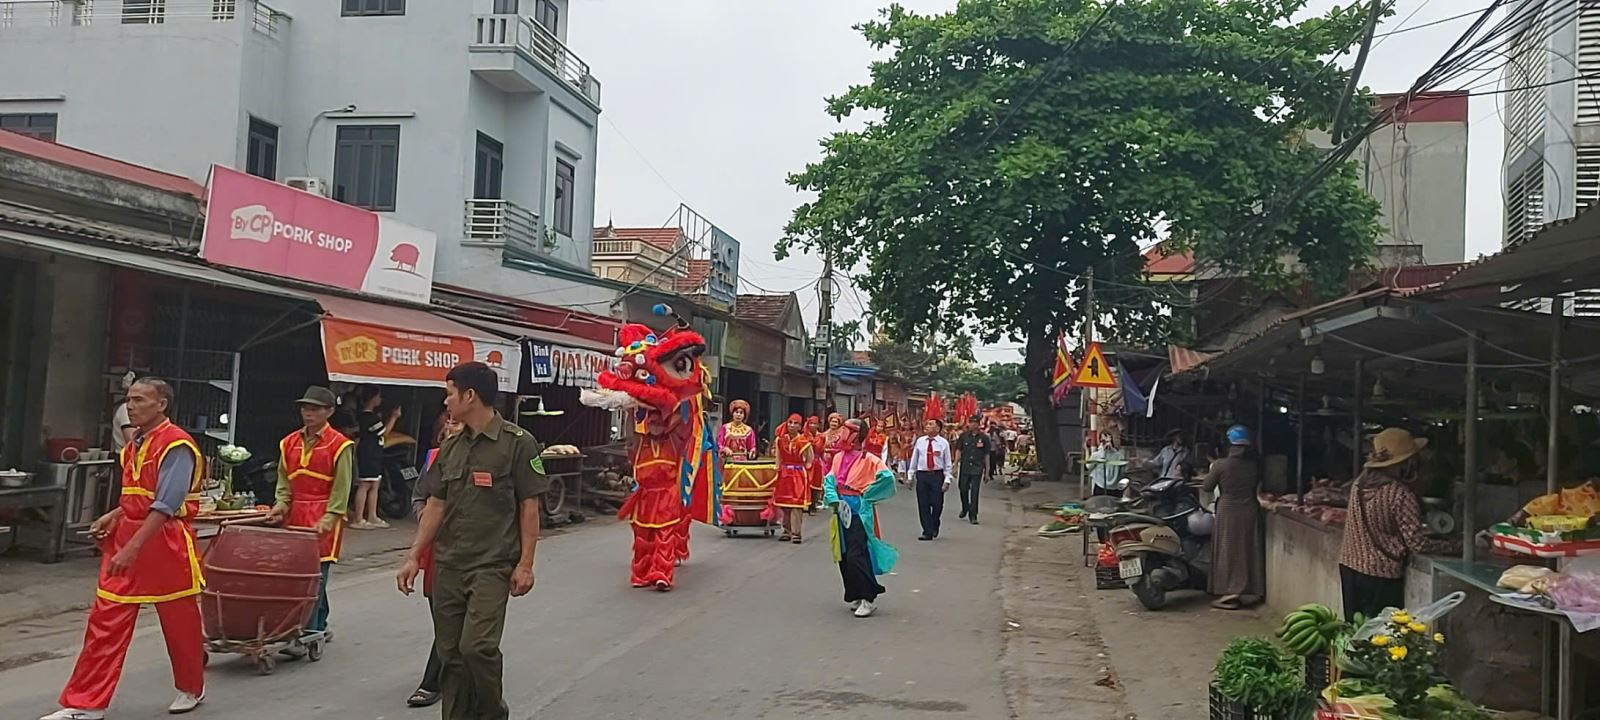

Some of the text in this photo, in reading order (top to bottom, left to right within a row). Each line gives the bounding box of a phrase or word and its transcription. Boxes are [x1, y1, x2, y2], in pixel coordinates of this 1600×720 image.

[250, 214, 272, 231] CP
[273, 220, 314, 245] PORK
[317, 232, 353, 254] SHOP
[355, 342, 369, 359] CP
[382, 346, 421, 367] PORK
[424, 350, 460, 369] SHOP
